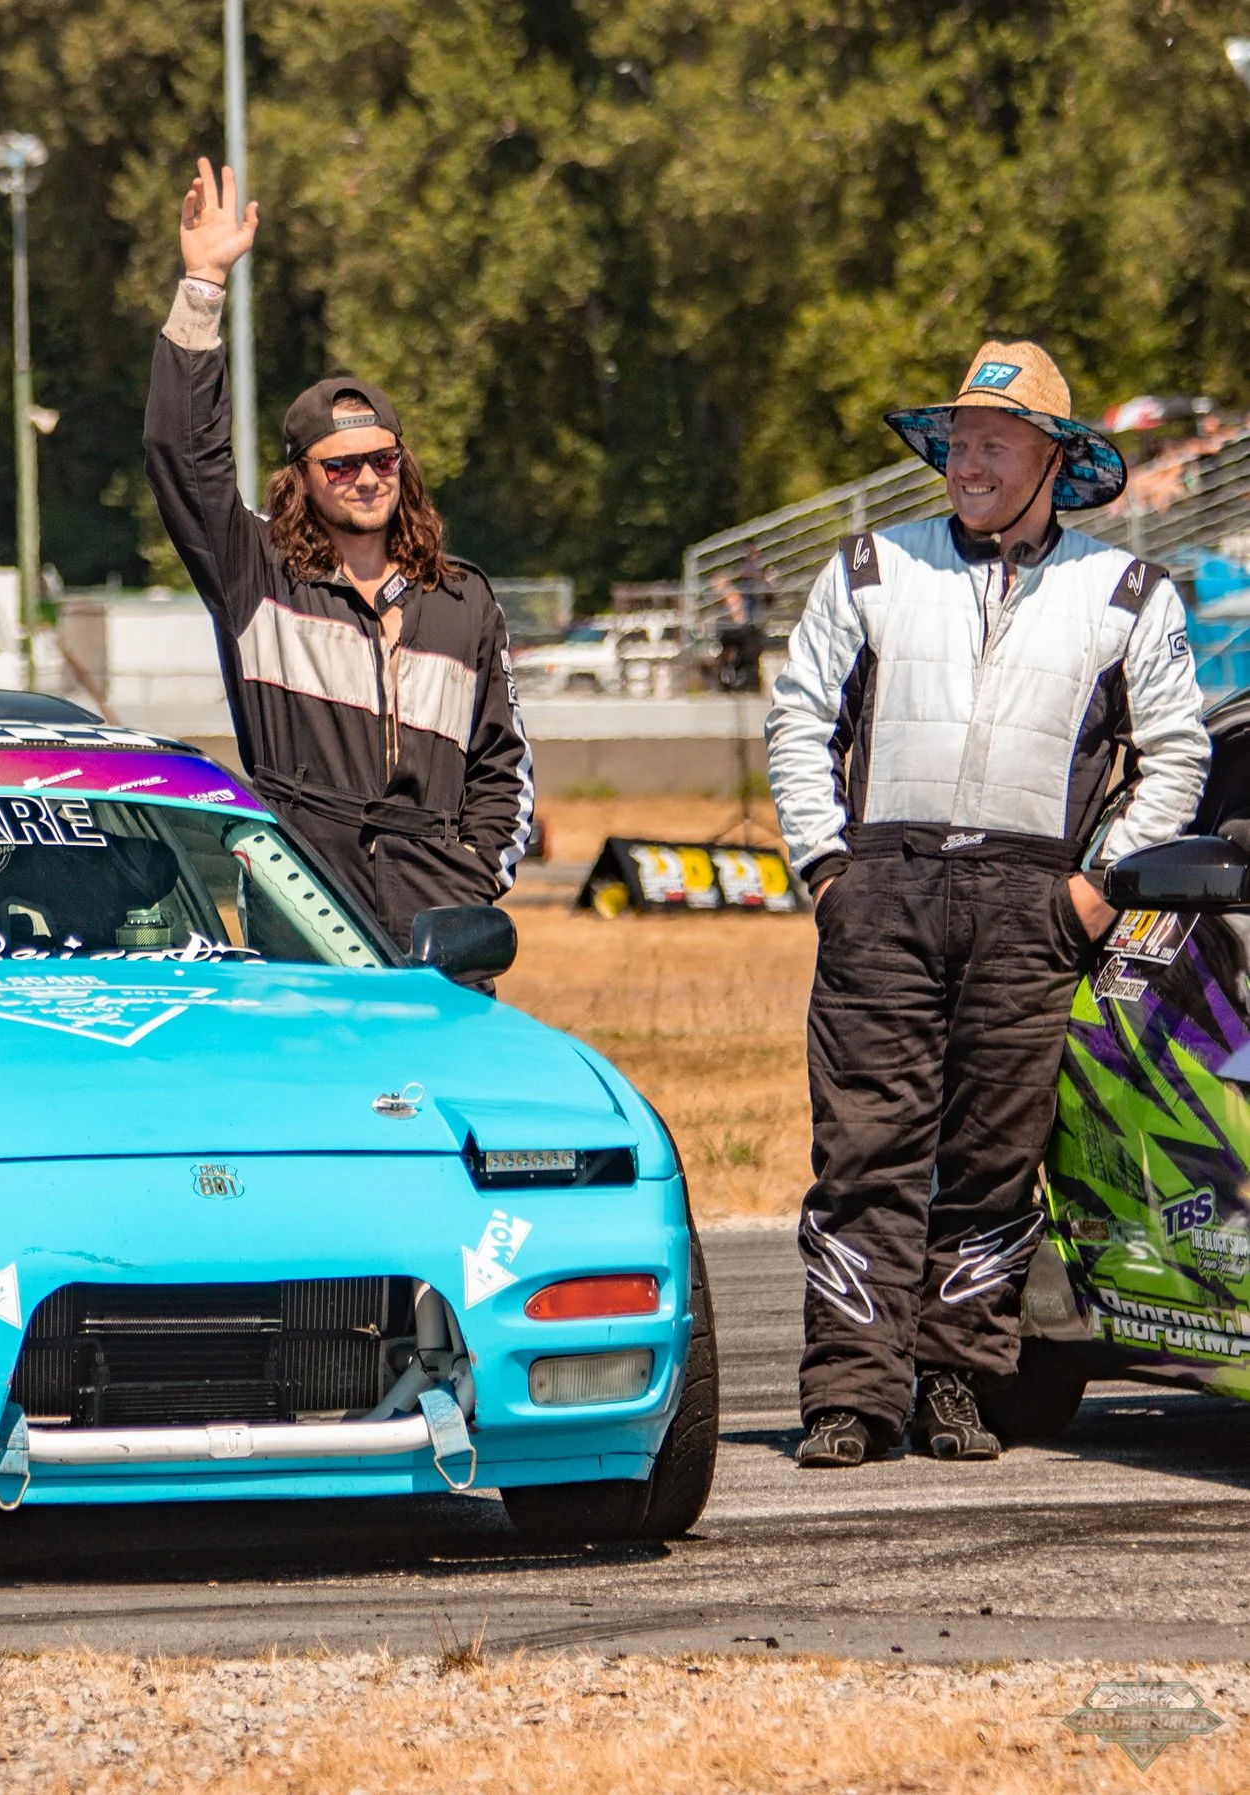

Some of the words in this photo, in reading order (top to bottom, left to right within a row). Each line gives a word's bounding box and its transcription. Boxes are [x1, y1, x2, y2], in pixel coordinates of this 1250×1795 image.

[199, 1164, 227, 1176] CREW
[198, 1175, 237, 1197] 881
[1161, 1192, 1214, 1237] TBS
[1191, 1227, 1205, 1250] THE
